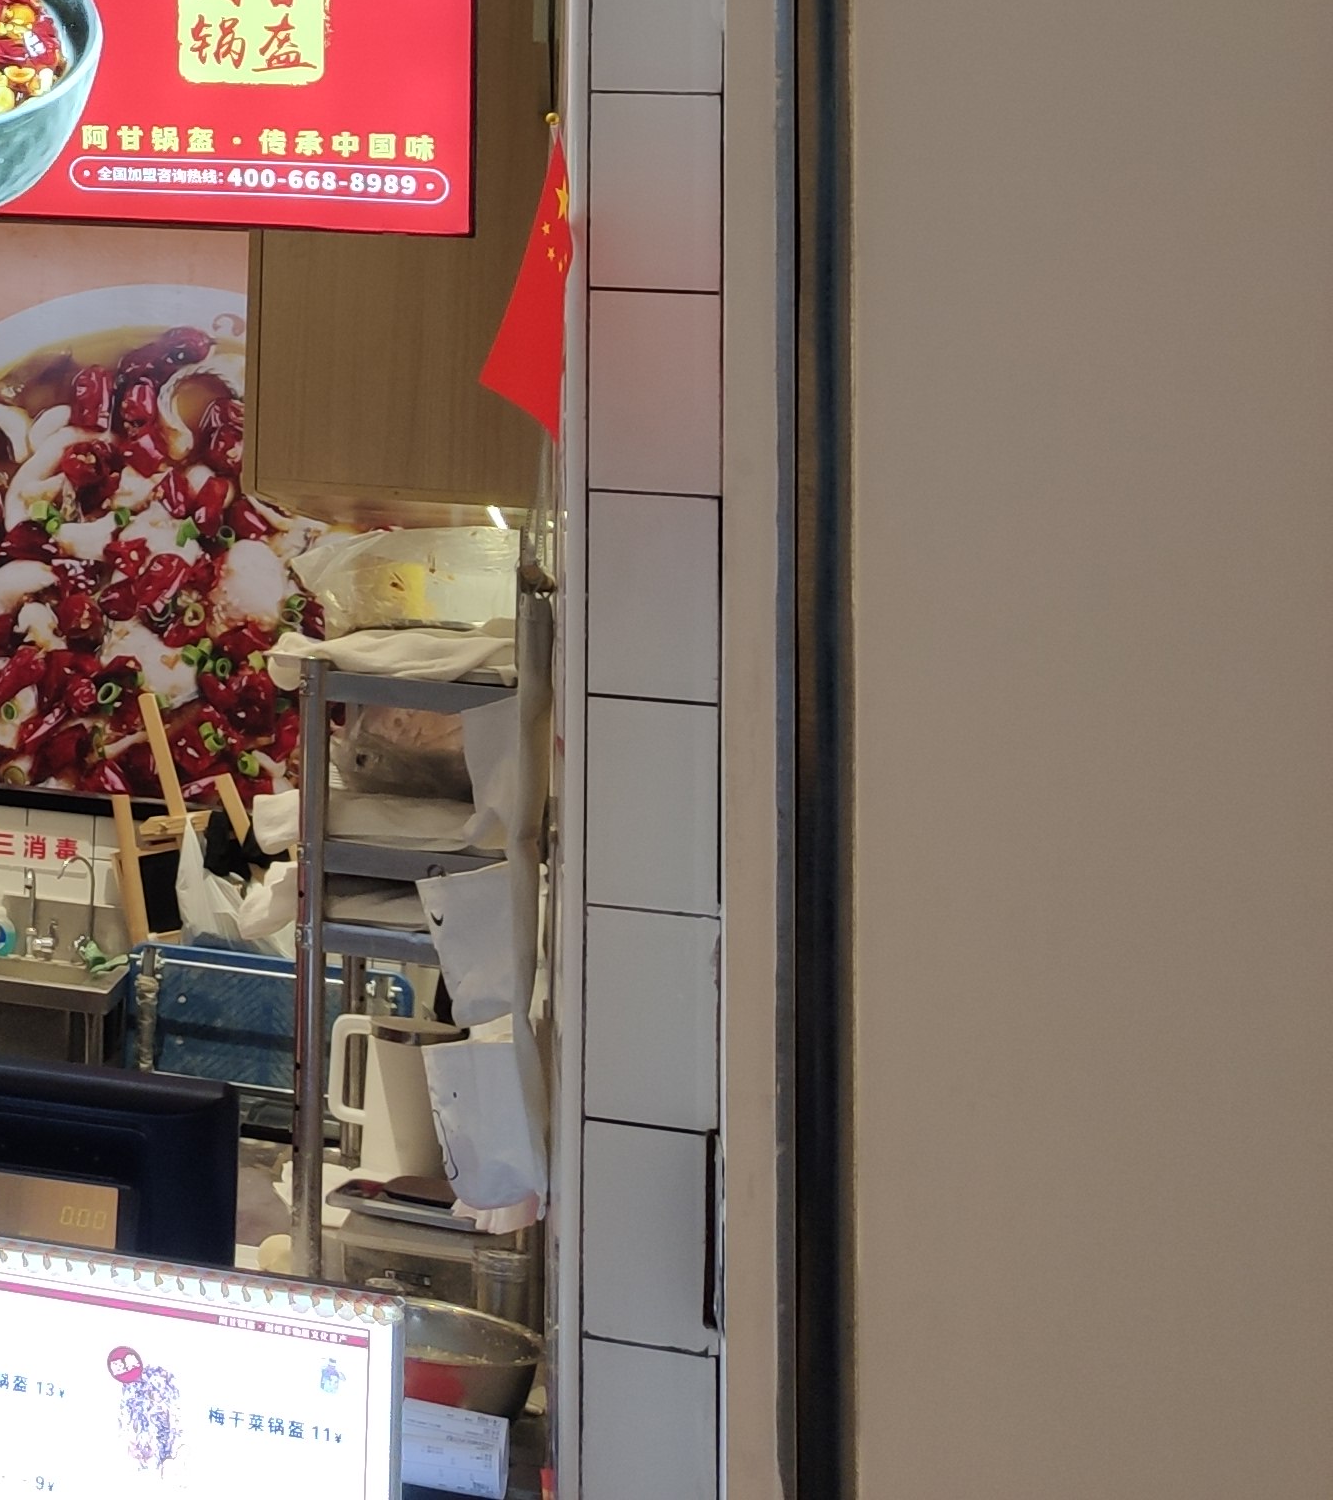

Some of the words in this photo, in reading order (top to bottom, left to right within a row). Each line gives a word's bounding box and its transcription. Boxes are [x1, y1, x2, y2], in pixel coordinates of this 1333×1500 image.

[208, 1405, 305, 1440] 梅干菜锅盔
